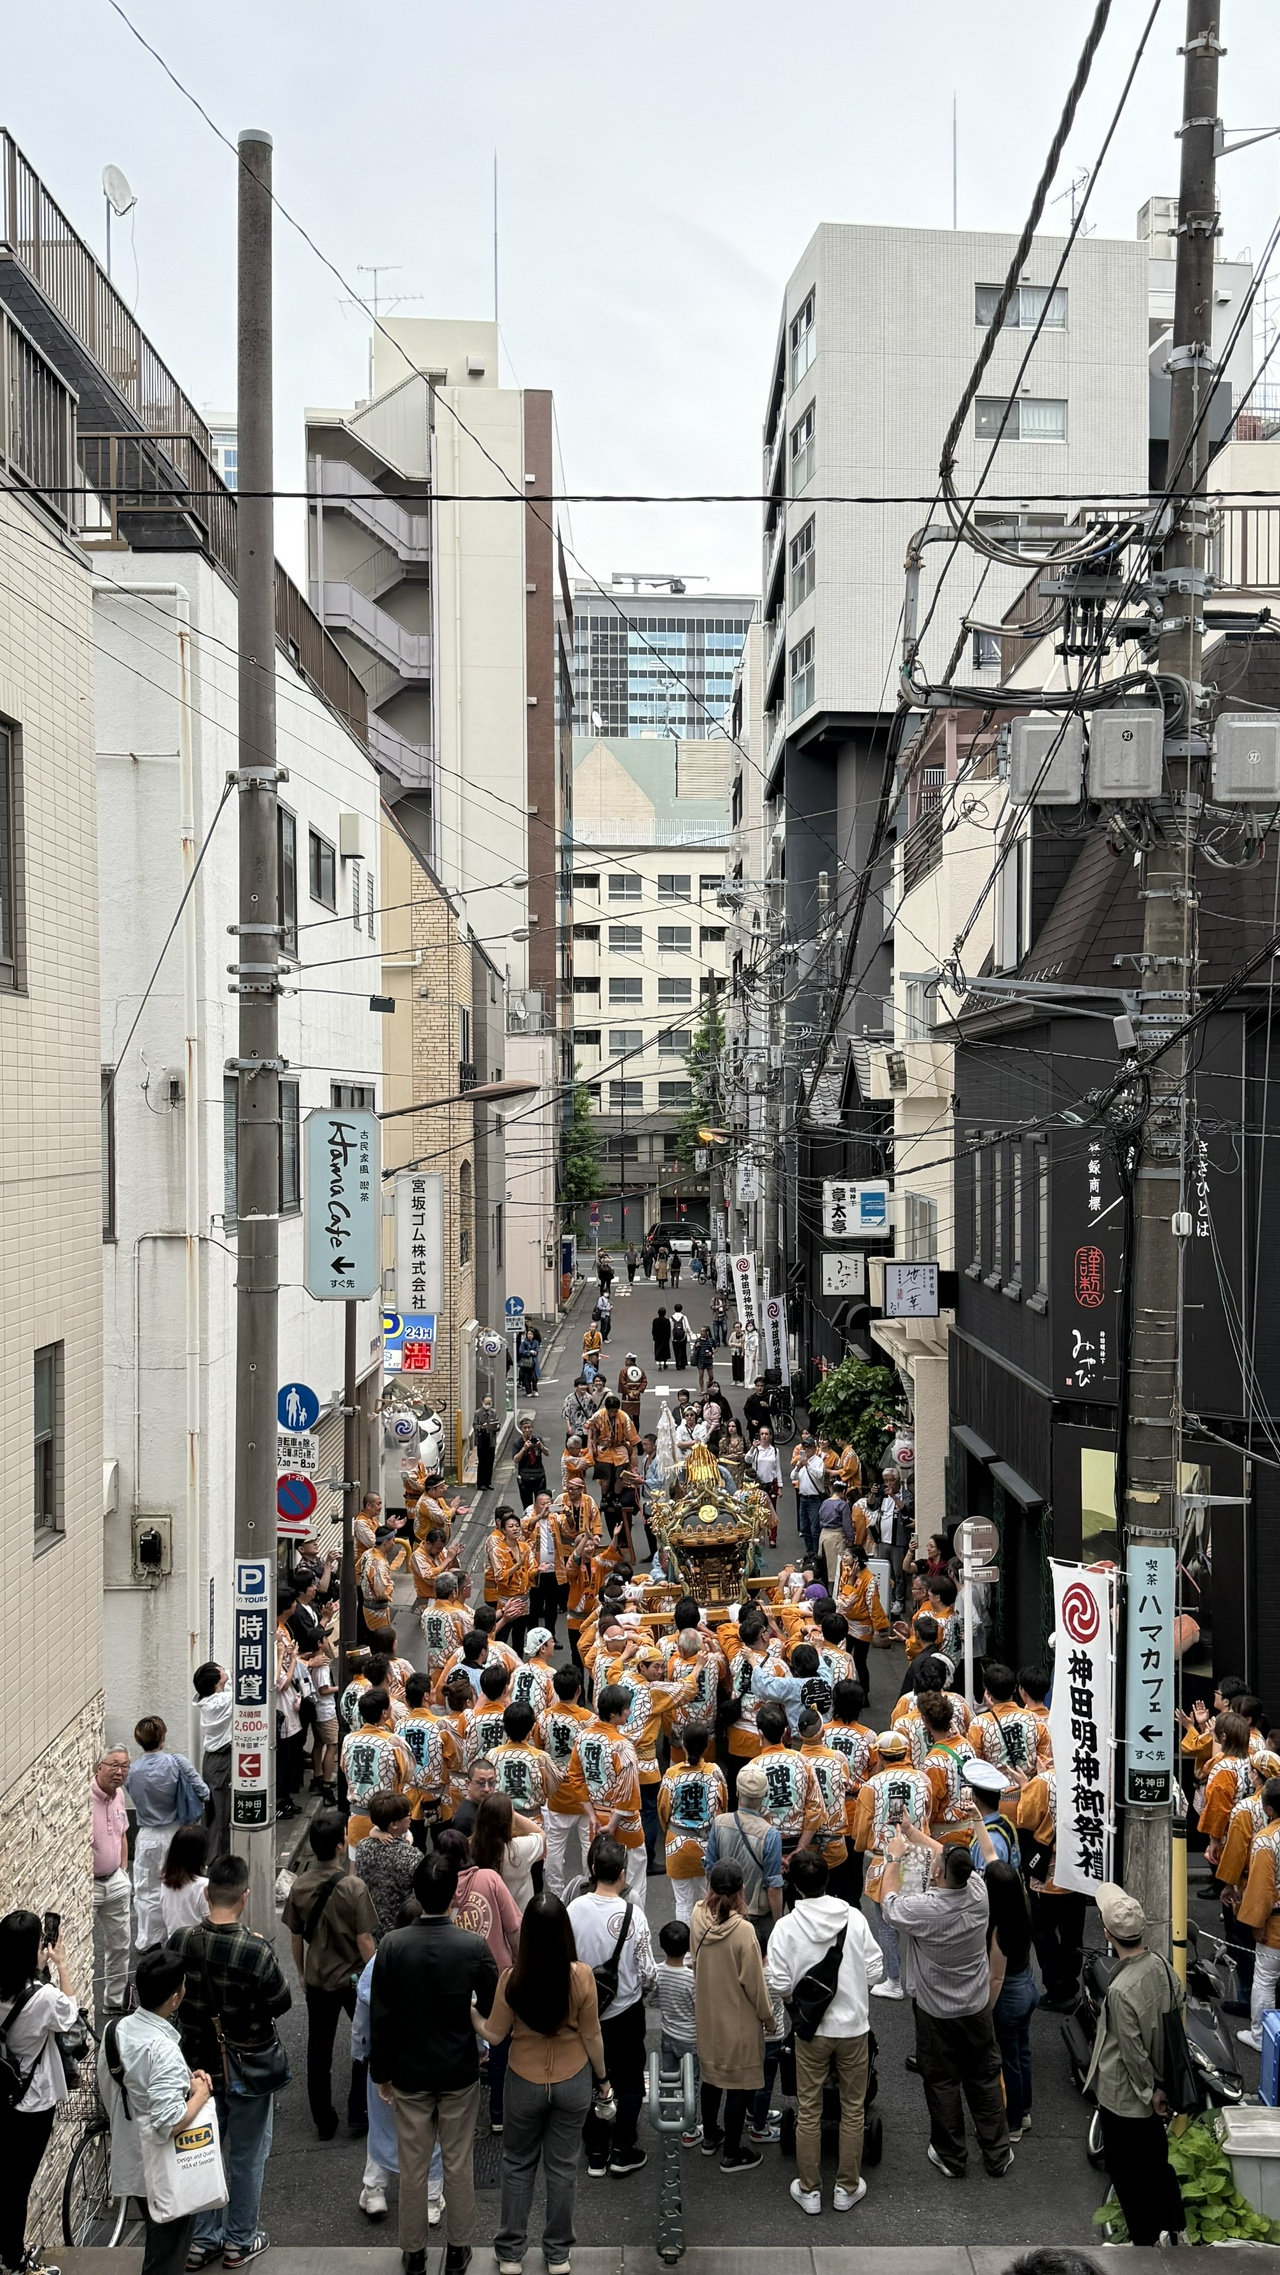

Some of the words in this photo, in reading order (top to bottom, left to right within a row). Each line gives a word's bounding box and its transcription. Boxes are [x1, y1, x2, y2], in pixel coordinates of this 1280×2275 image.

[328, 1120, 357, 1198] Hama
[411, 1179, 427, 1310] 宮坂ゴム株式会社
[330, 1279, 355, 1289] すぐ先
[405, 1326, 432, 1339] 24H
[404, 1342, 431, 1371] 満
[1072, 1329, 1097, 1387] みやび
[240, 1568, 263, 1592] P
[1145, 1559, 1158, 1586] 喫茶
[238, 1615, 264, 1700] 時間貸
[1138, 1595, 1164, 1713] ハマカフェ
[239, 1710, 261, 1719] 24時間
[234, 1720, 268, 1732] 2,600円
[1134, 1750, 1165, 1760] すぐ先
[1134, 1777, 1165, 1787] 外神田
[1139, 1789, 1160, 1799] 2-7
[237, 1800, 262, 1808] 外神田
[237, 1810, 261, 1818] 2-7
[455, 1910, 479, 1930] GAP
[178, 2130, 212, 2146] IKEA
